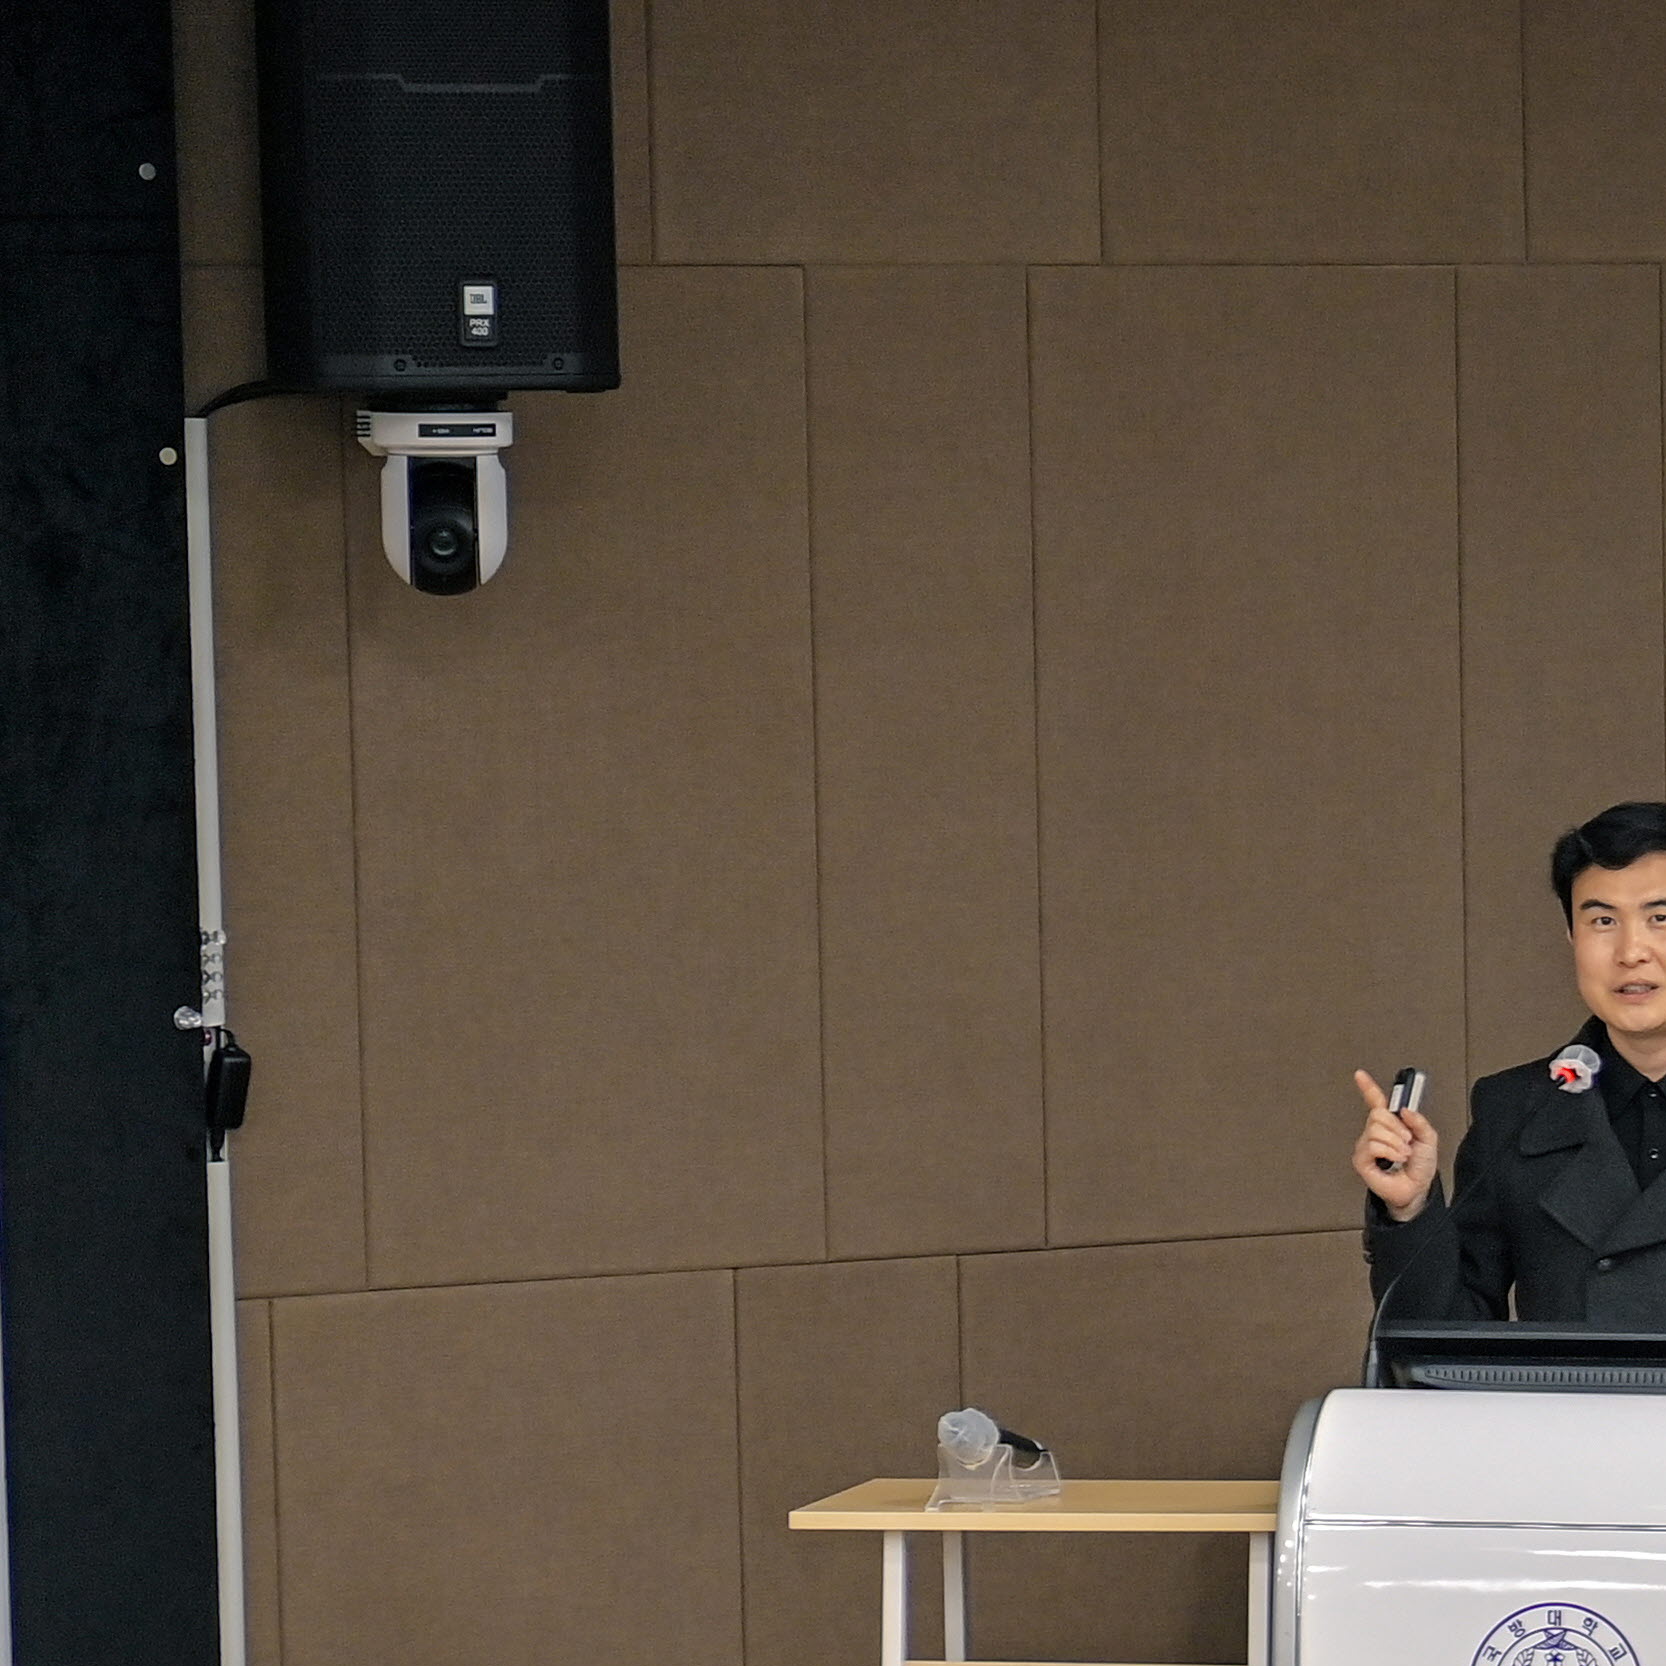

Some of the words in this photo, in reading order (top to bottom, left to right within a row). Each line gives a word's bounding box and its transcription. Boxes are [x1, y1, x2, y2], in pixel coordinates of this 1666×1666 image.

[469, 294, 488, 304] JBL
[469, 318, 490, 327] PRX
[1482, 1609, 1628, 1662] 국방대학교
